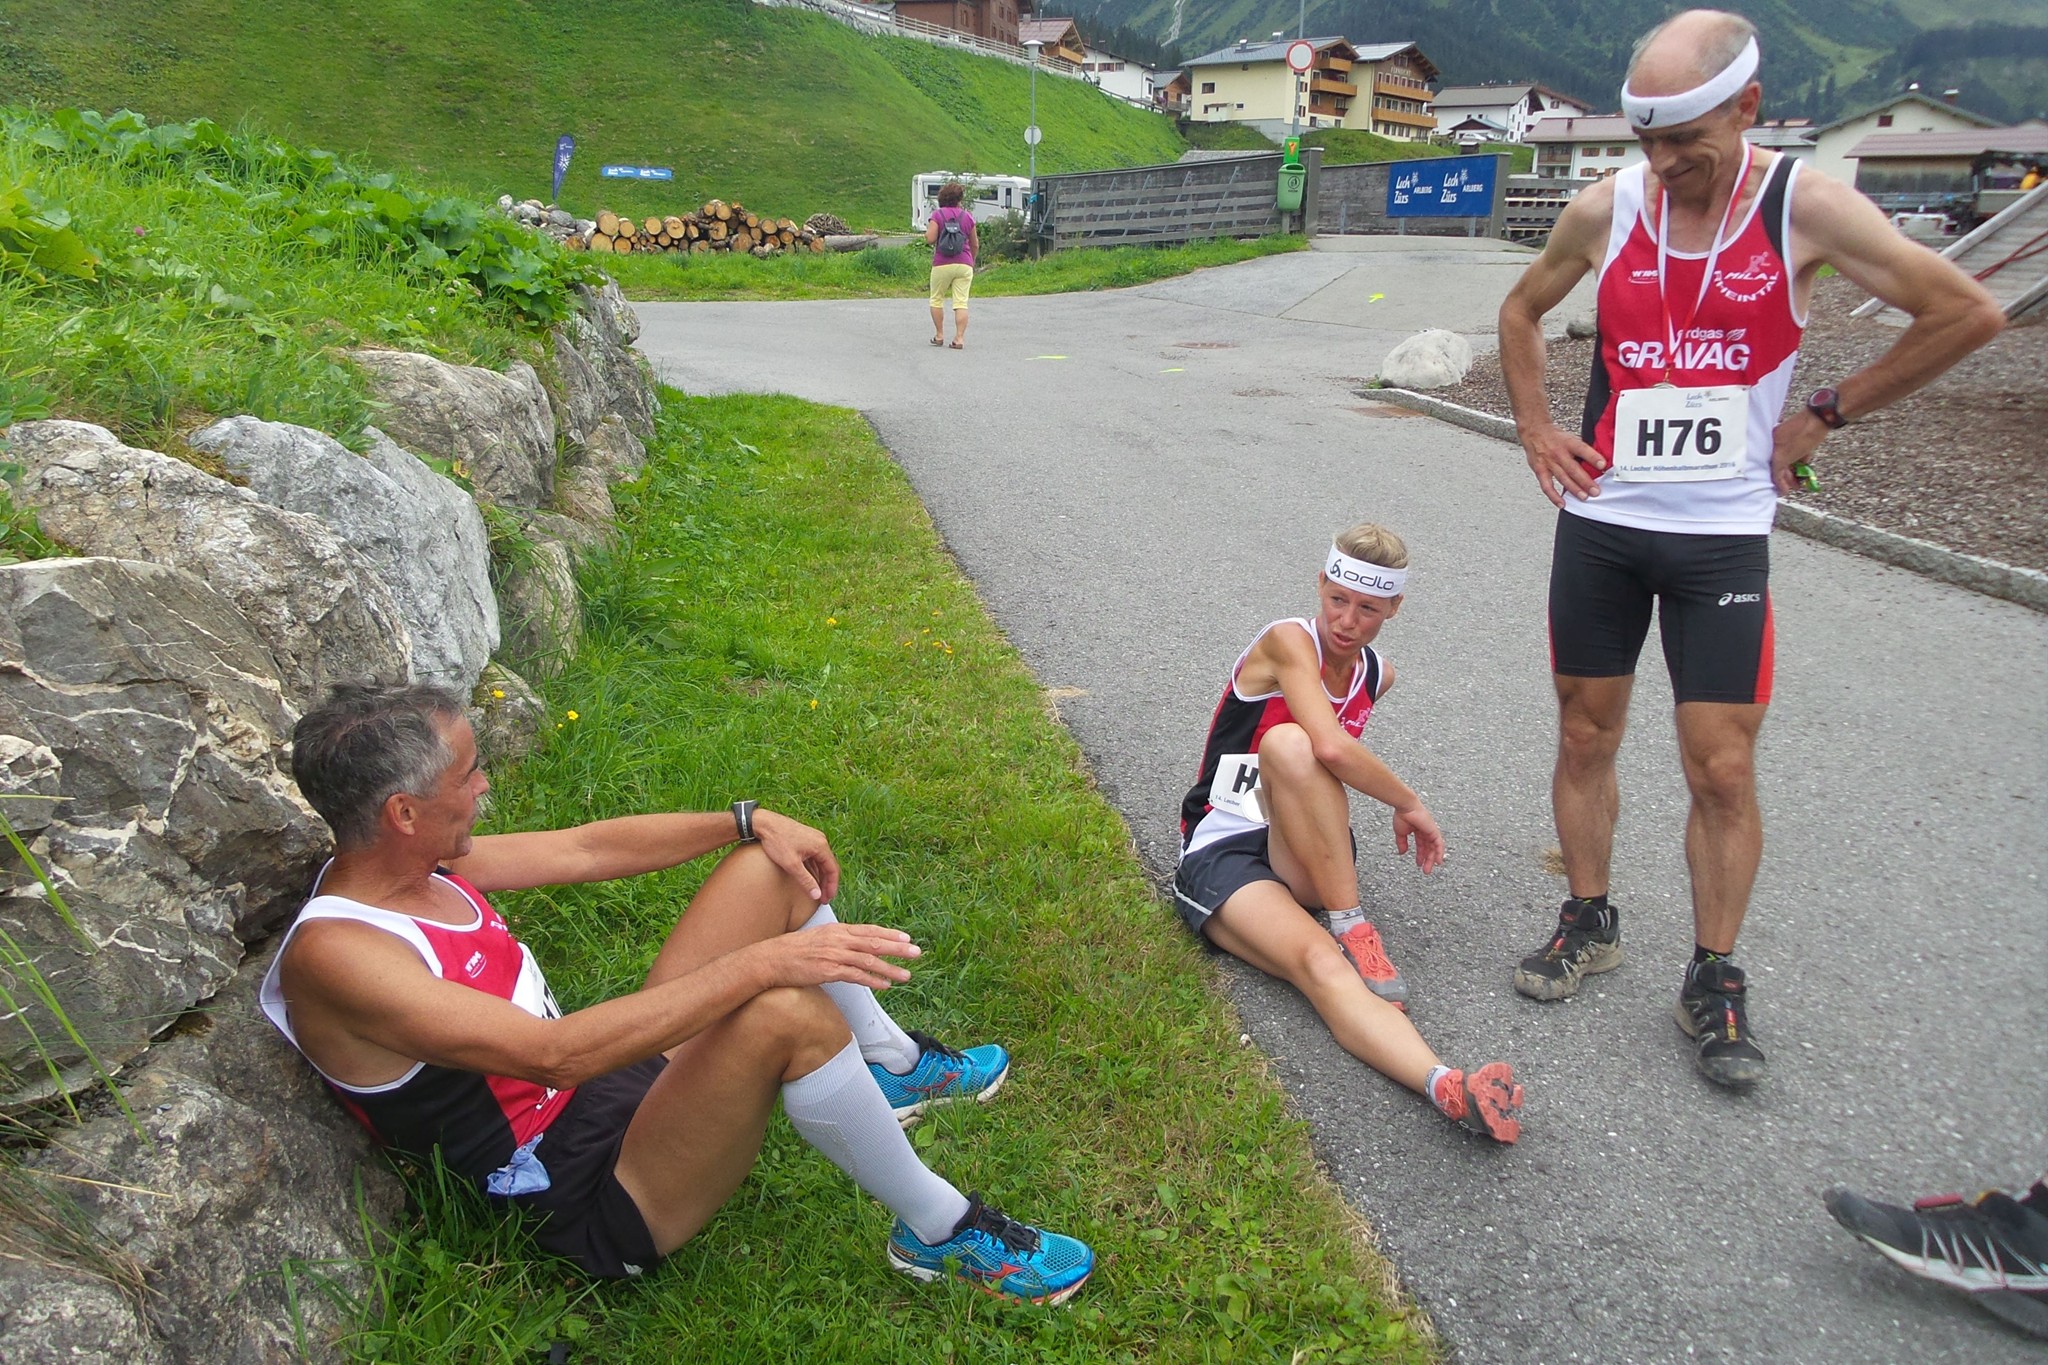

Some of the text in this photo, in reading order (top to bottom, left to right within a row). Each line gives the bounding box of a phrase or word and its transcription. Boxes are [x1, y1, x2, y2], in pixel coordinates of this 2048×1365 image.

[1443, 172, 1459, 187] Lech
[1637, 417, 1722, 457] H76
[1344, 570, 1395, 591] odlo
[1733, 593, 1760, 603] asics
